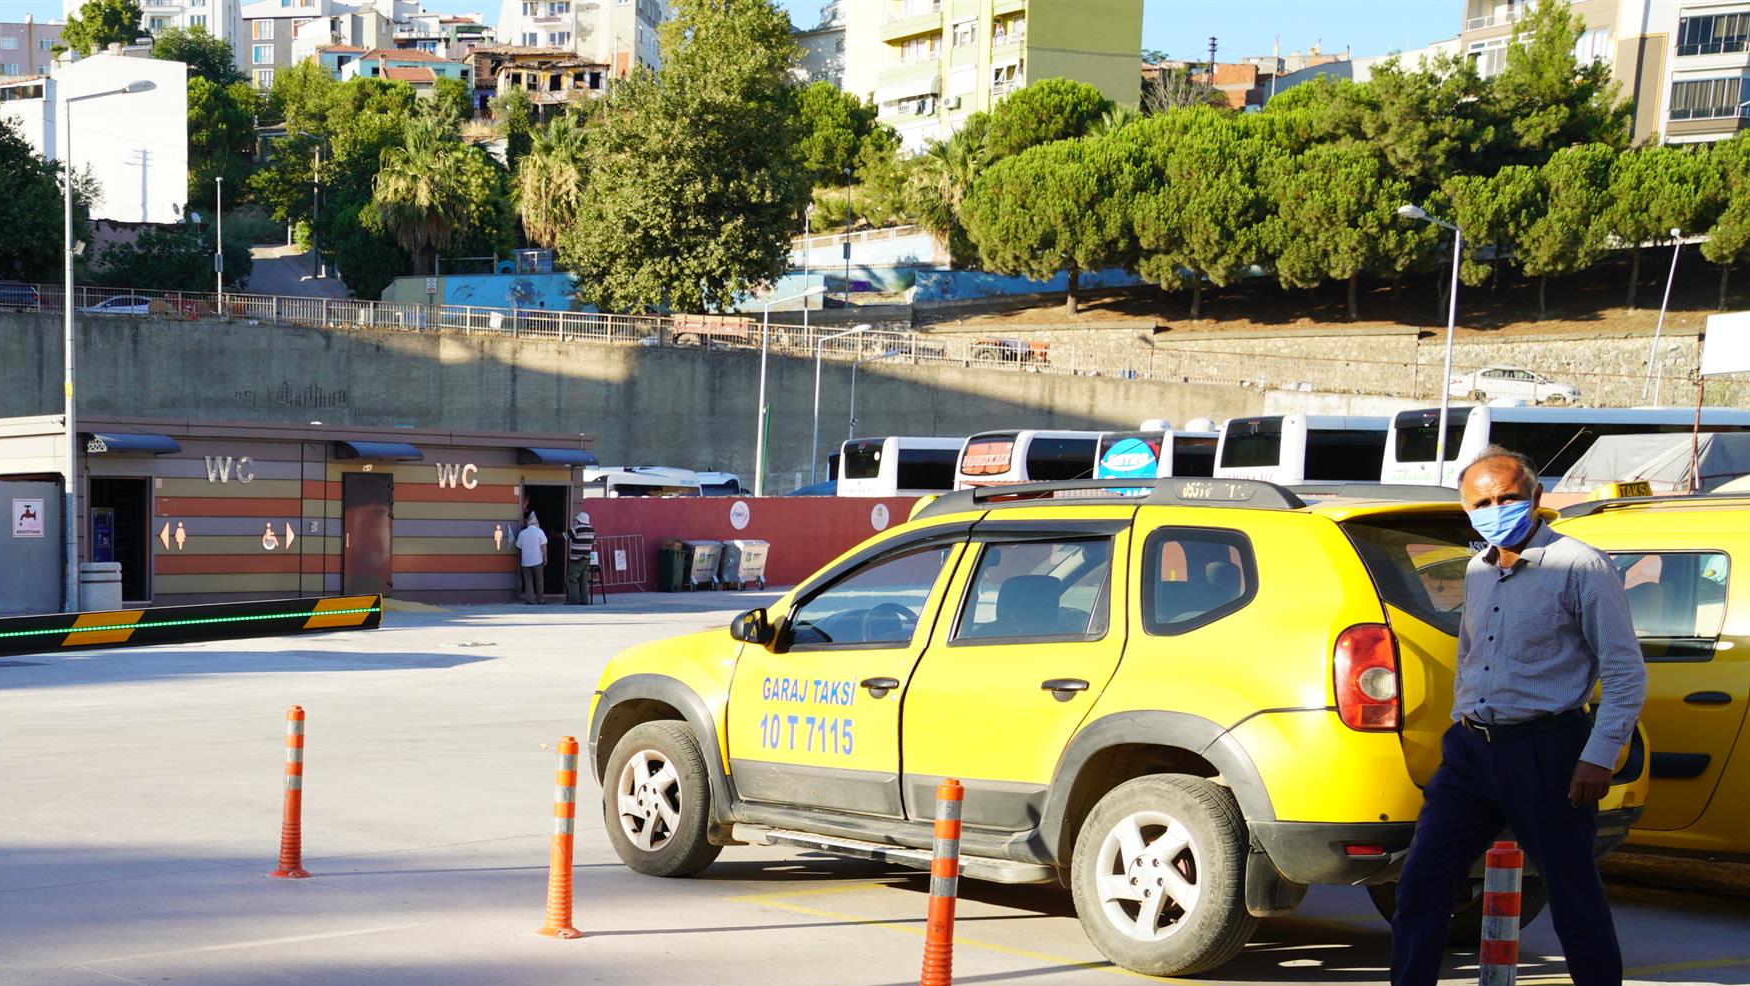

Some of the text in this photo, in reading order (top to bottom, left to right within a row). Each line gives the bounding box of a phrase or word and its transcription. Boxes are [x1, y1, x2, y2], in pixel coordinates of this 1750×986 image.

[205, 455, 255, 484] WC
[436, 463, 479, 490] WC
[762, 676, 857, 706] GARAJ TAKSİ
[761, 713, 854, 755] 10 T 7115
